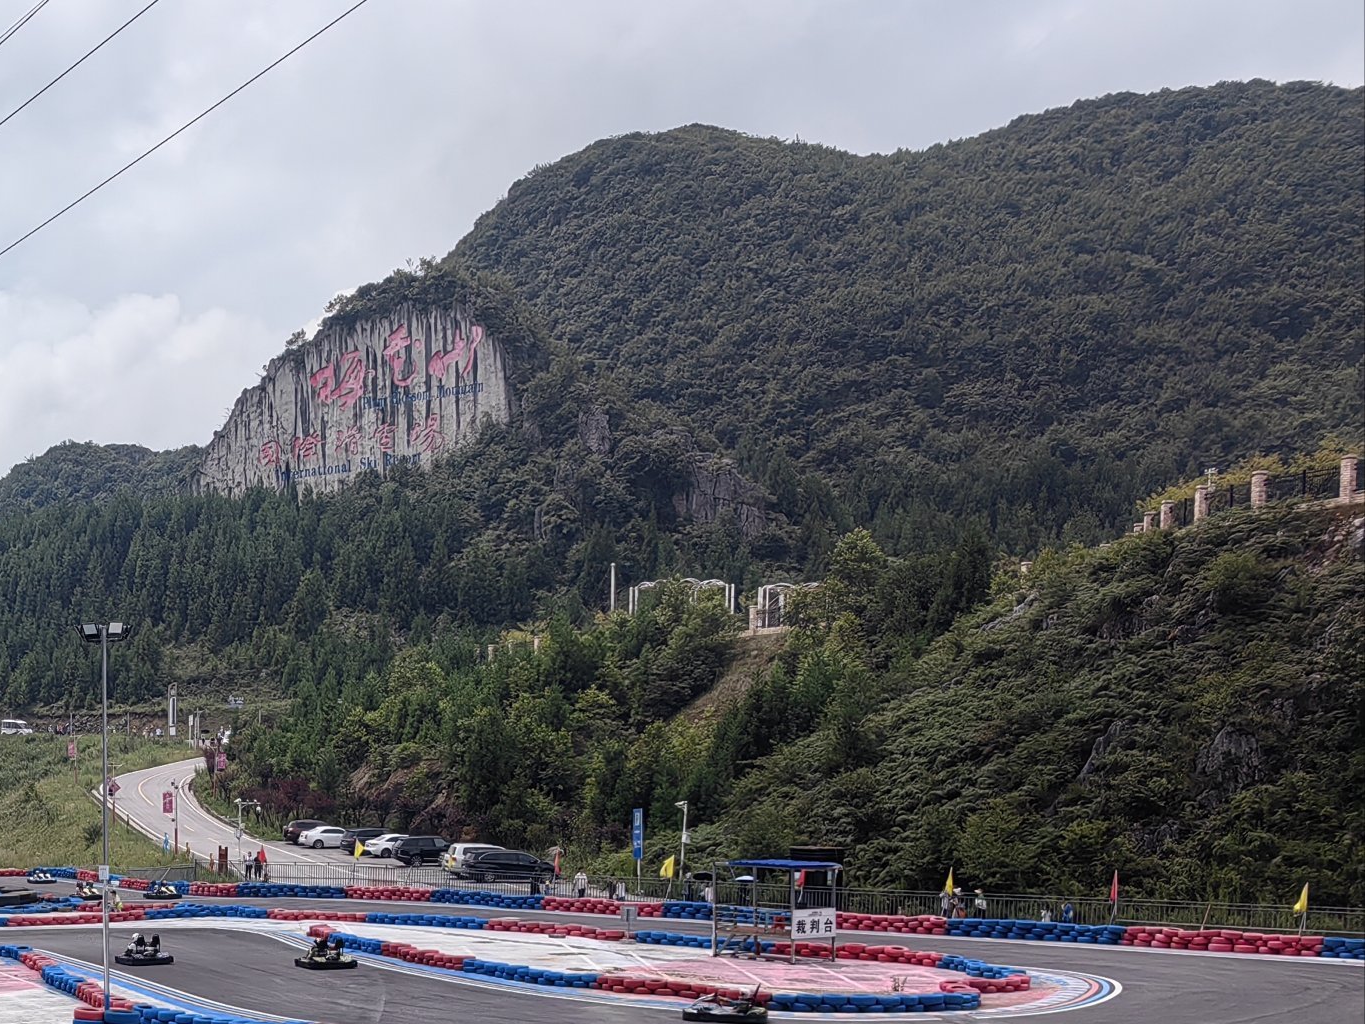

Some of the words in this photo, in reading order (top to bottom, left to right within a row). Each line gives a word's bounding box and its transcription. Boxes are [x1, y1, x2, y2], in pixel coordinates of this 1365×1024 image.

[362, 396, 385, 411] Plum
[391, 389, 431, 405] Blossom
[436, 381, 484, 399] Mountain
[275, 459, 351, 480] International
[359, 456, 378, 470] Ski
[795, 917, 833, 935] 裁判台
